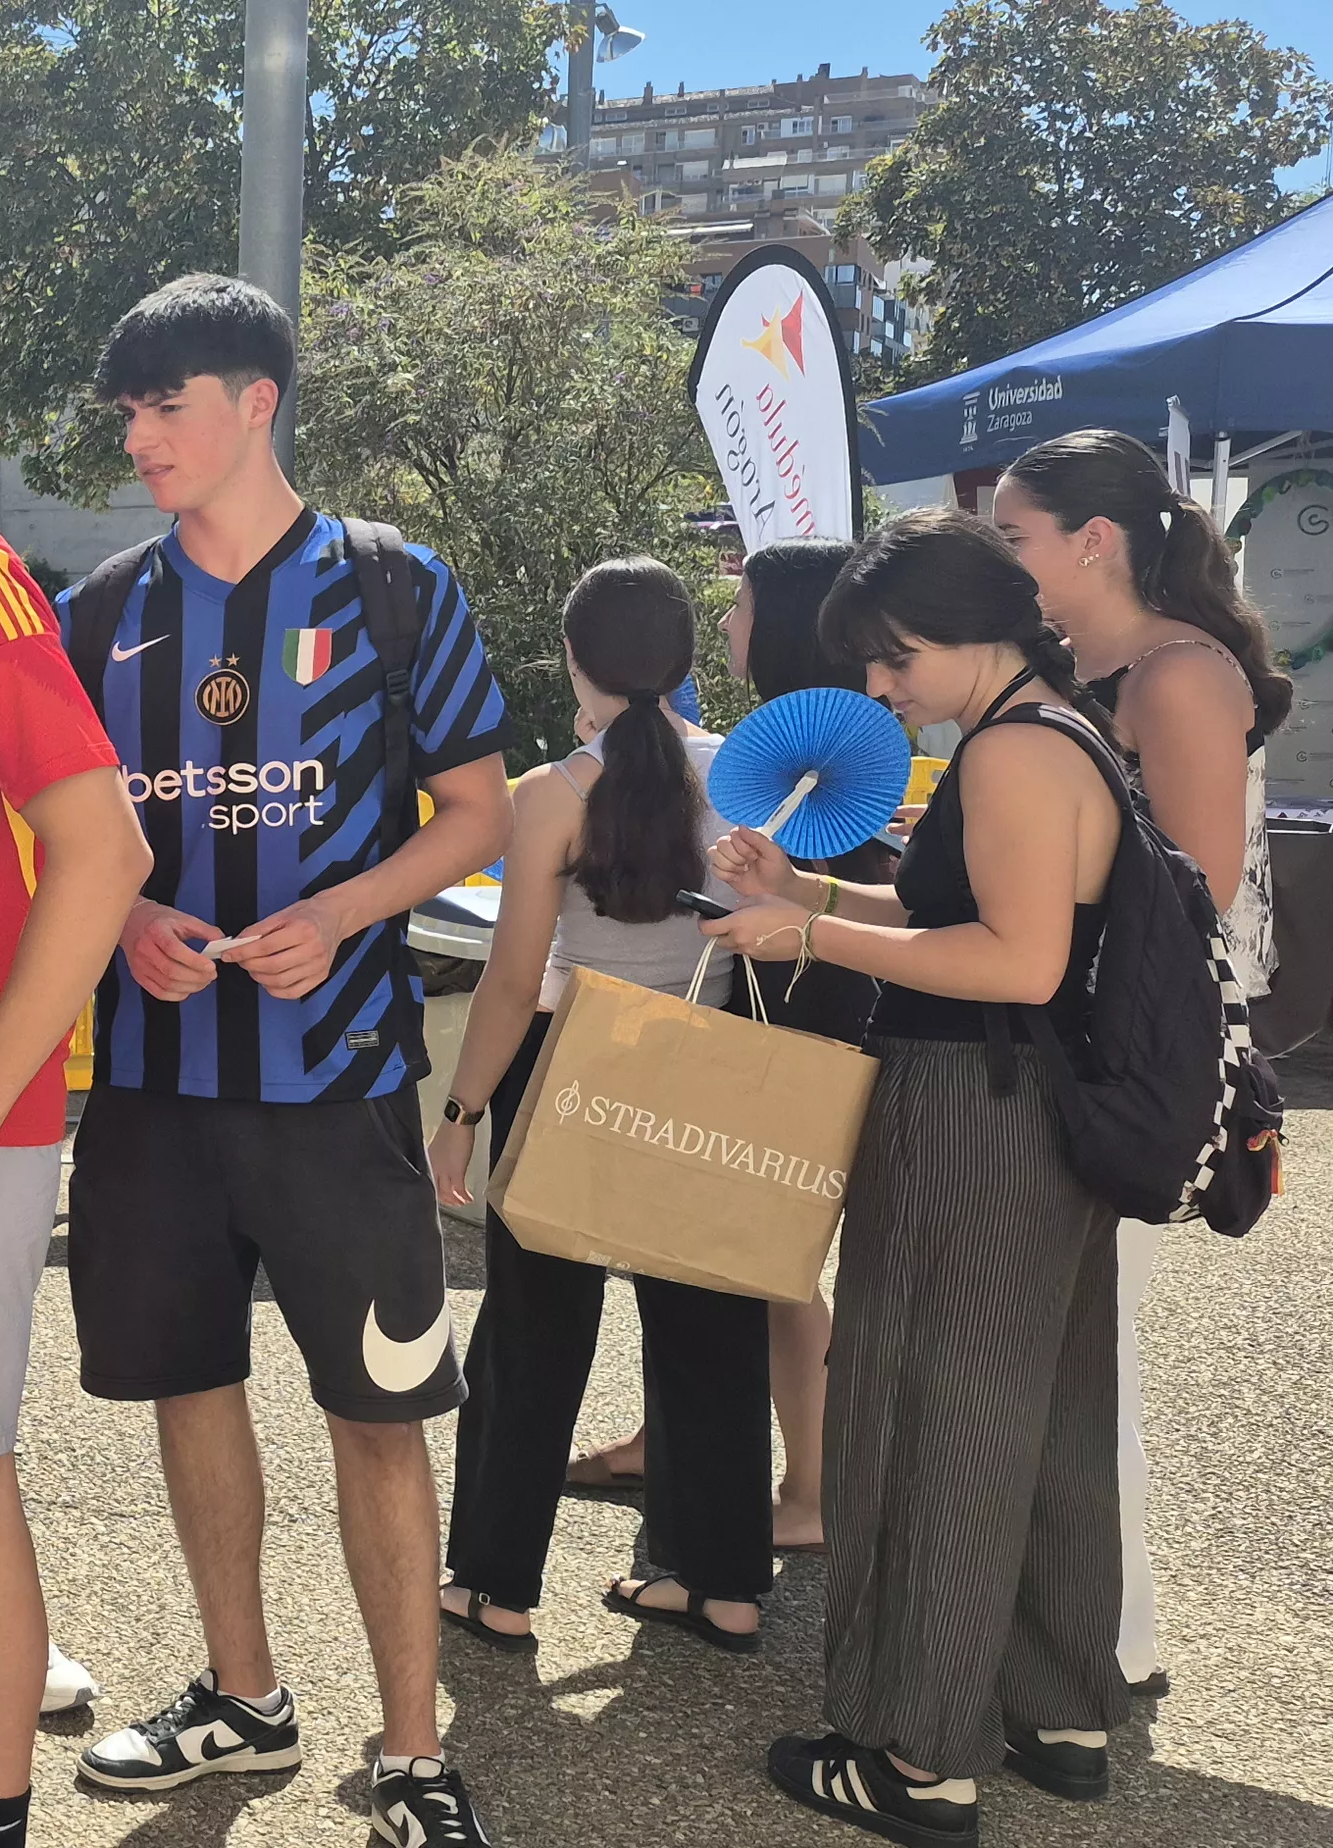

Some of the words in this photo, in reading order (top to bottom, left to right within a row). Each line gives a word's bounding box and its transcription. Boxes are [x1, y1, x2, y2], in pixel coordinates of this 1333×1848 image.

[989, 375, 1062, 410] Universidad
[987, 411, 1033, 432] Zaragoza
[122, 760, 324, 803] betsson
[584, 1096, 847, 1199] STRADIVARIUS
